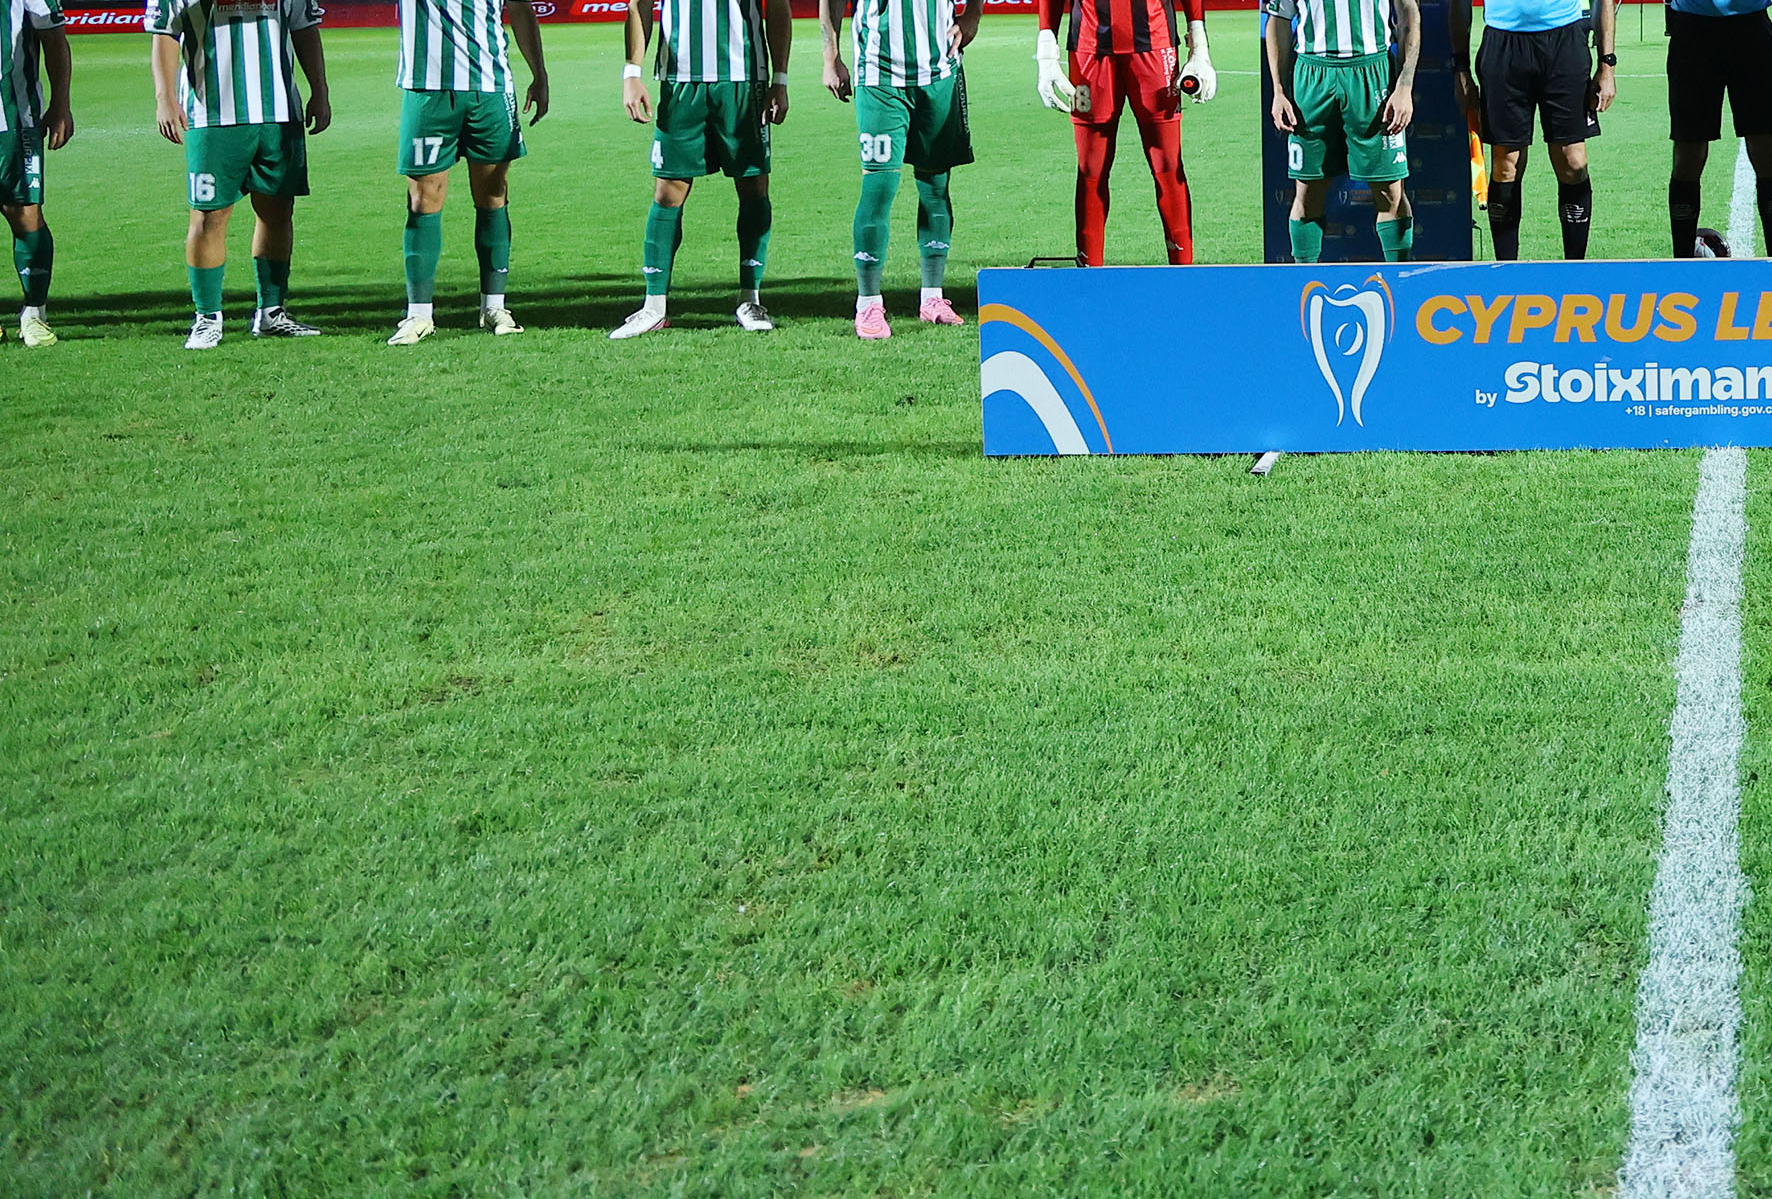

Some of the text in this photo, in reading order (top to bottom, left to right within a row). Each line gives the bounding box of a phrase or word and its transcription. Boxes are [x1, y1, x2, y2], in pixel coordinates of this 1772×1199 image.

[412, 136, 443, 165] 17
[859, 132, 892, 164] 30
[189, 172, 216, 202] 16
[1415, 292, 1700, 344] CYPRUS
[1475, 389, 1498, 408] by
[1625, 406, 1646, 416] +18
